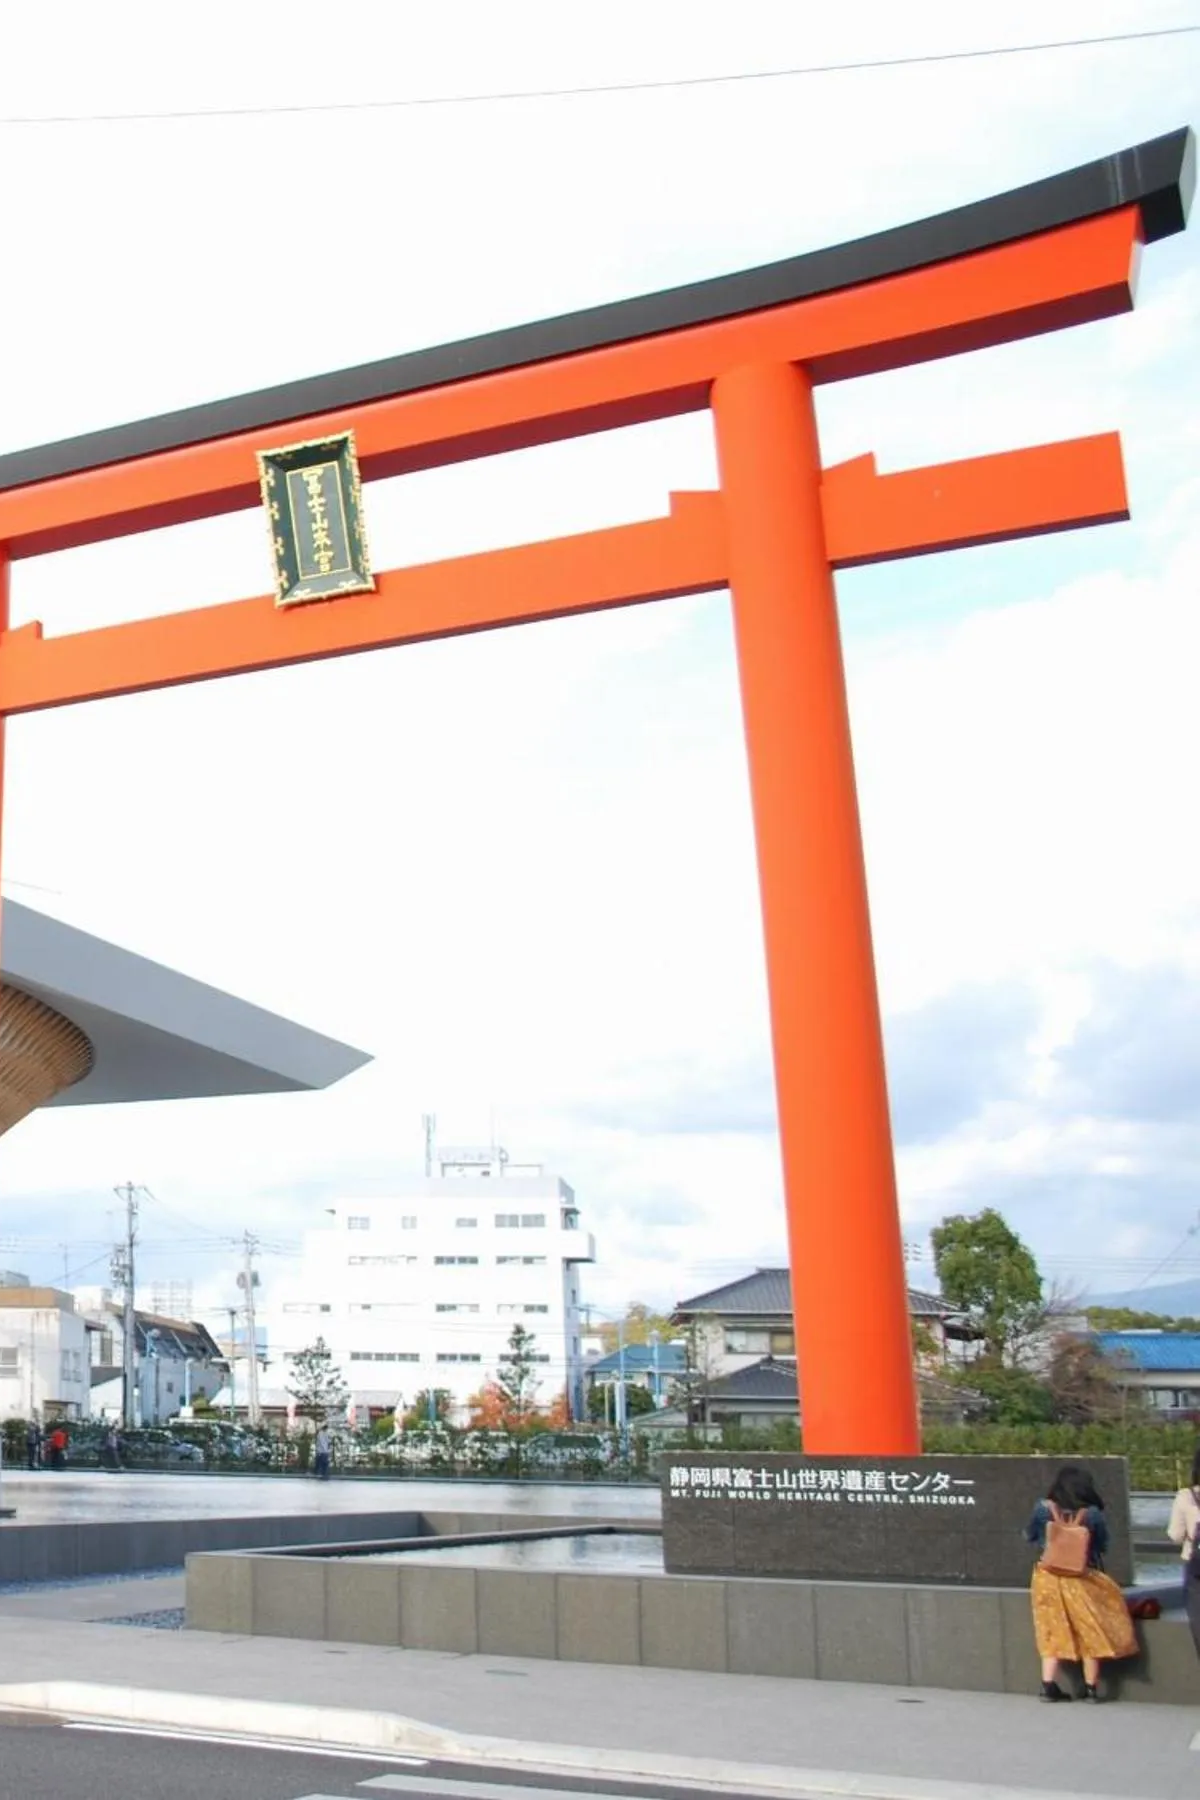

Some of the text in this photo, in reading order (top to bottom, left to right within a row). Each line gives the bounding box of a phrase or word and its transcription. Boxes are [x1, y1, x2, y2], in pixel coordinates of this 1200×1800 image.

[670, 1466, 975, 1492] 静岡県富士山世界遺産センター
[670, 1488, 691, 1498] MT.
[695, 1489, 721, 1499] FUJI
[728, 1489, 771, 1500] WORLD
[777, 1491, 840, 1501] HERITAGE
[909, 1494, 975, 1505] SHIZUOKA
